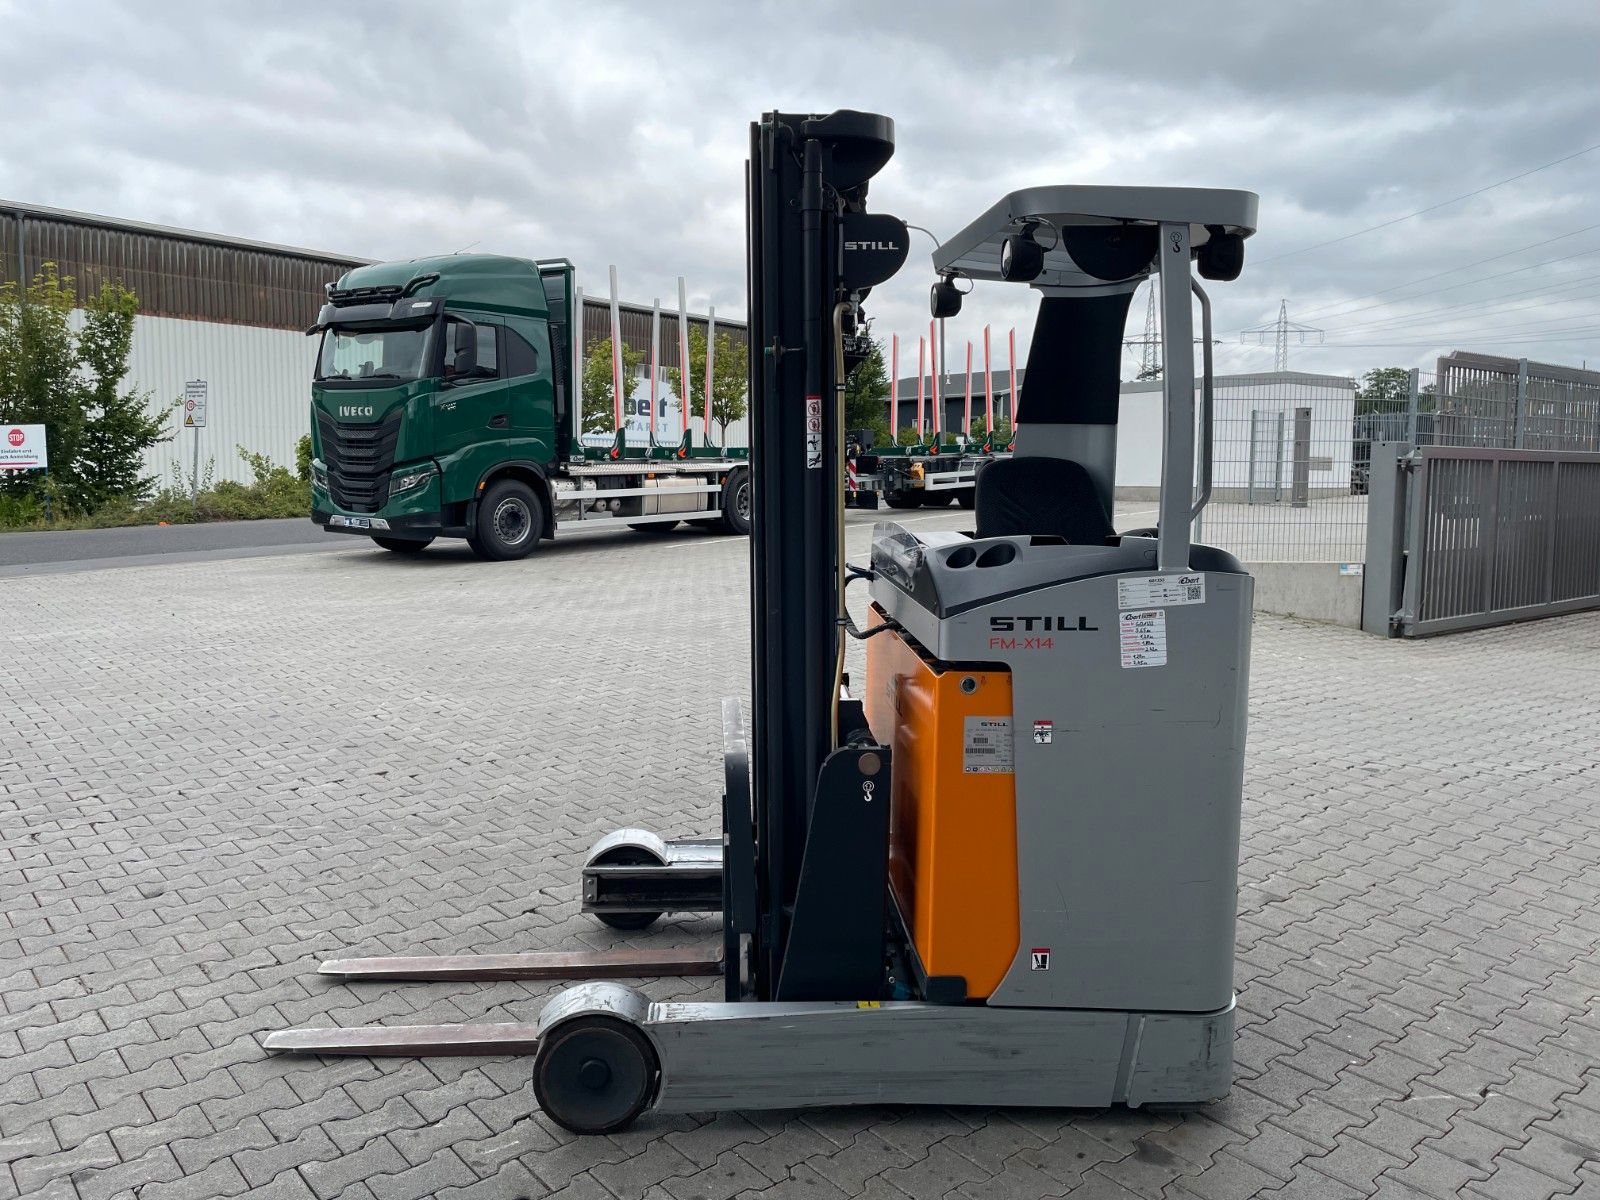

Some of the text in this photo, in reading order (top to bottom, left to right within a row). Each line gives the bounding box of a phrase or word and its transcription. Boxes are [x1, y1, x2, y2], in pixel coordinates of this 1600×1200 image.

[844, 241, 899, 250] STILL
[339, 405, 373, 417] IVECO
[8, 433, 24, 442] STOP
[989, 616, 1099, 631] STILL
[989, 637, 1054, 650] FM-X14
